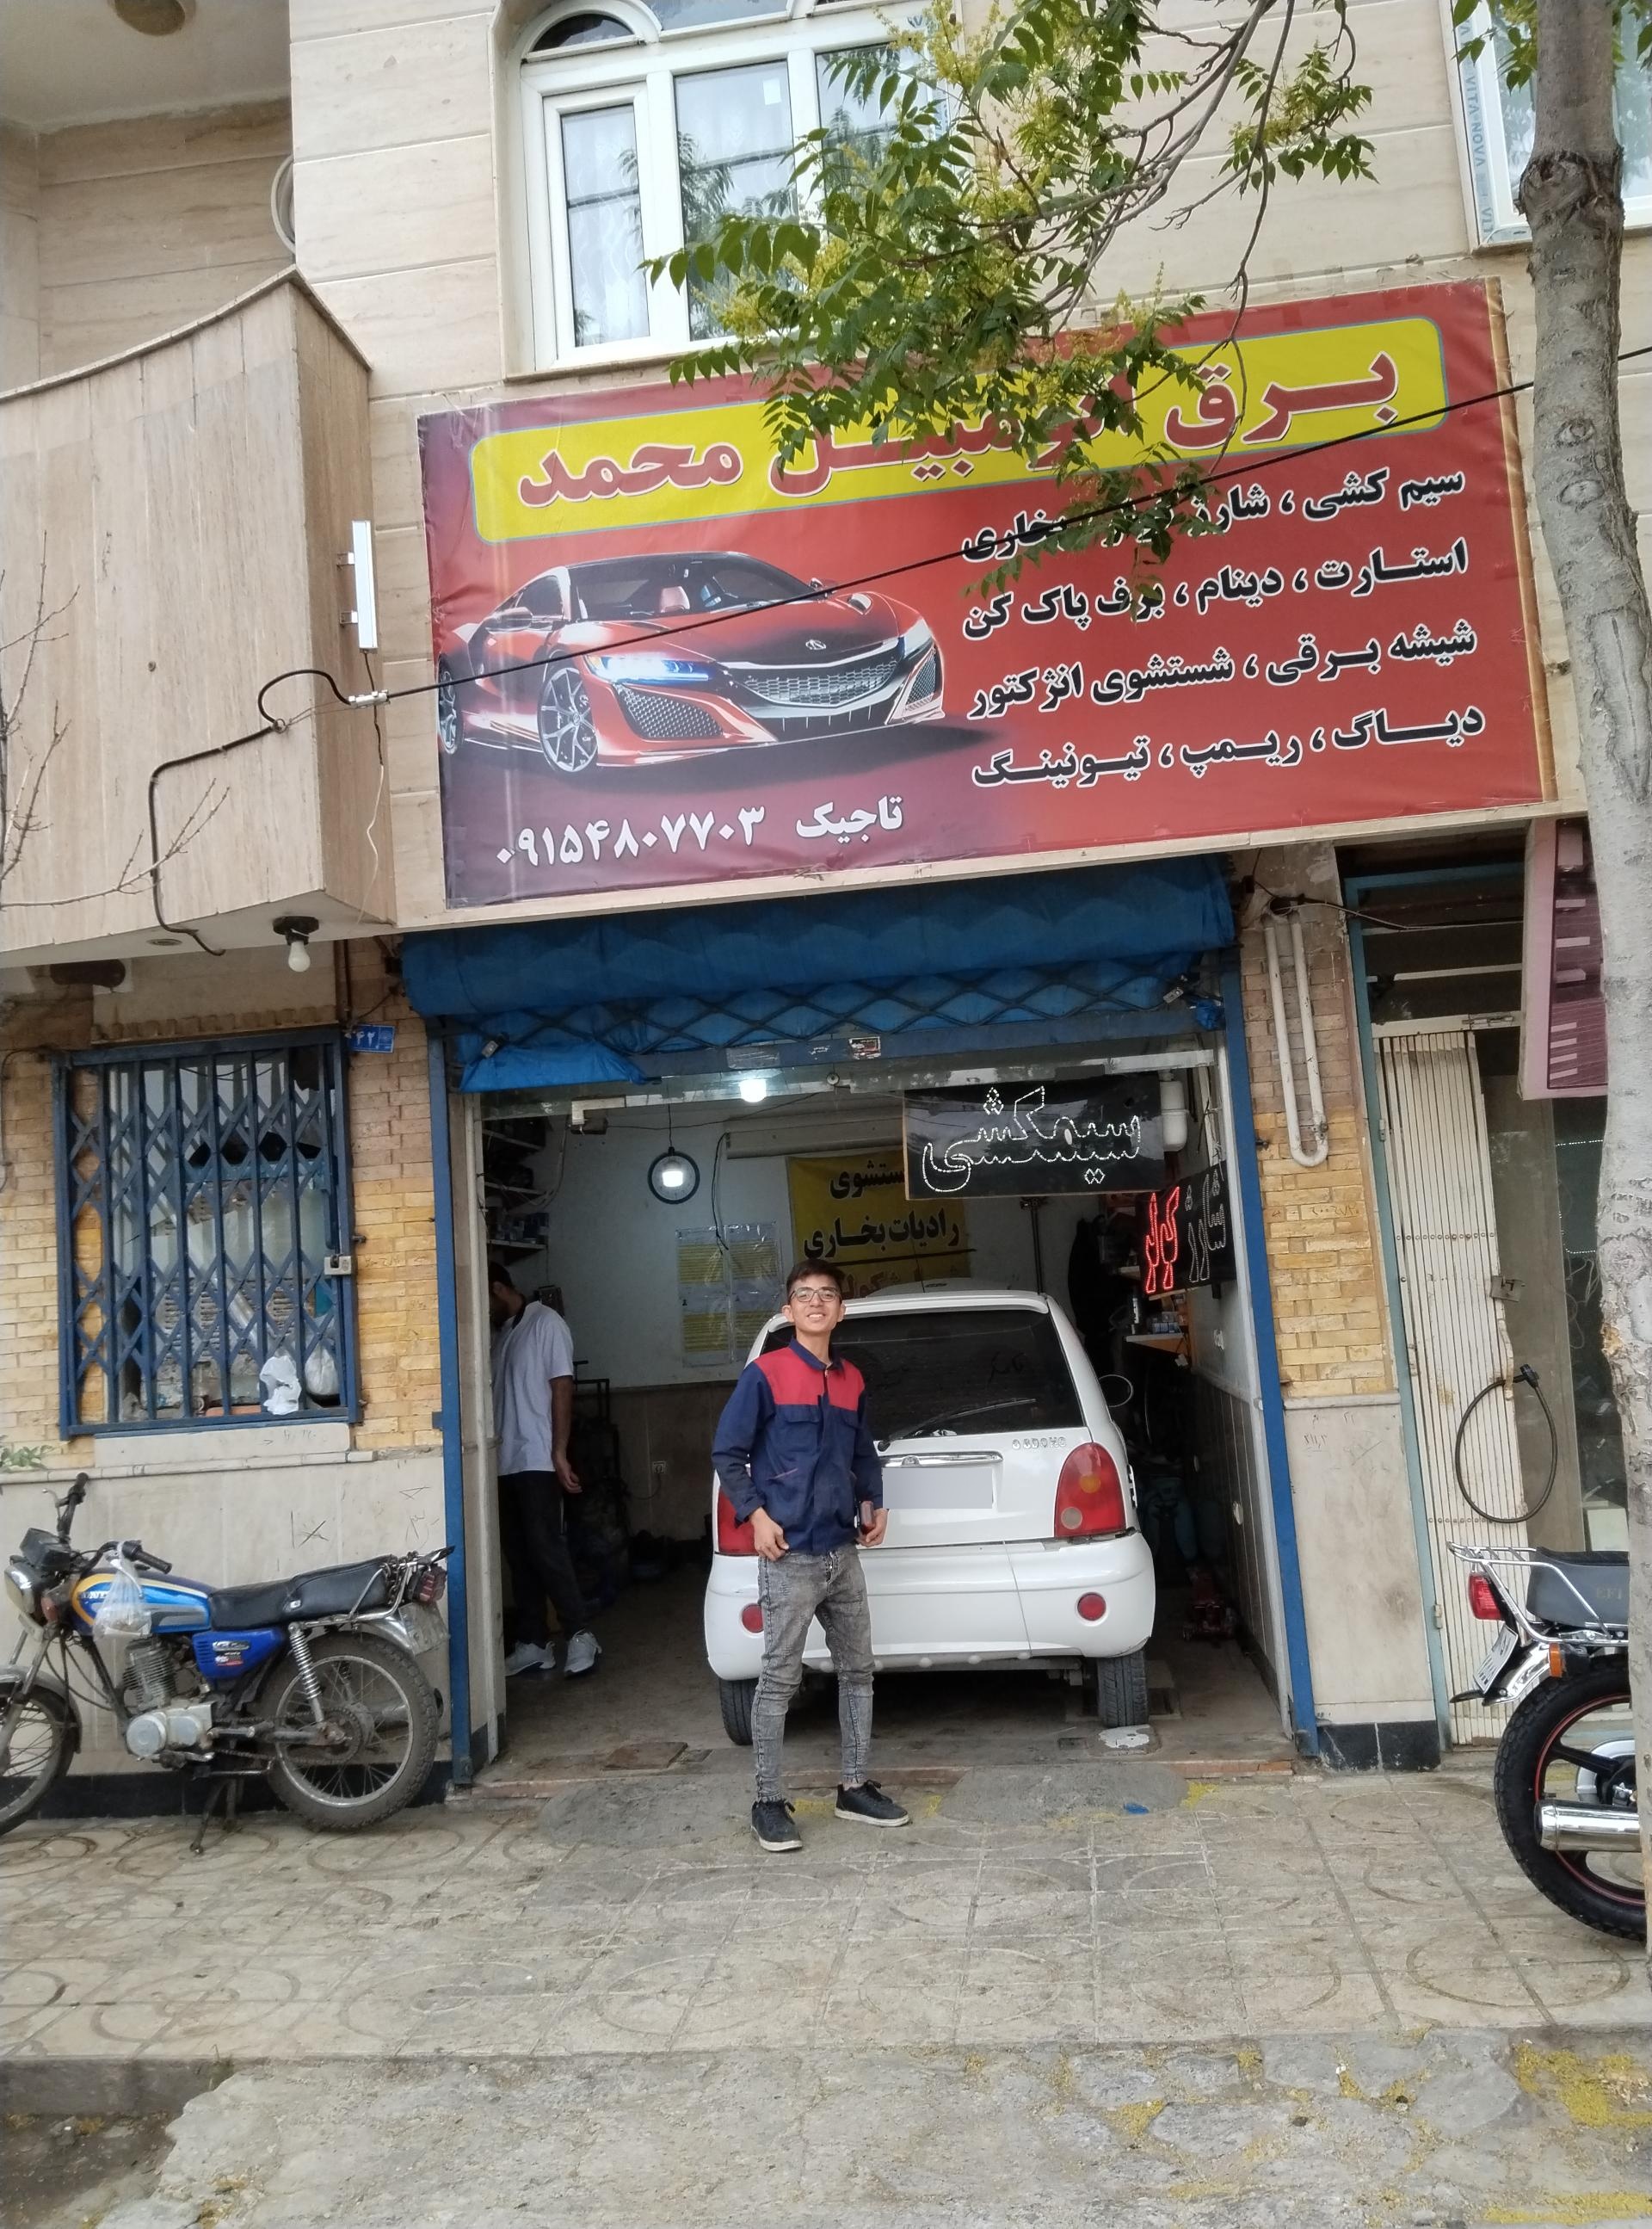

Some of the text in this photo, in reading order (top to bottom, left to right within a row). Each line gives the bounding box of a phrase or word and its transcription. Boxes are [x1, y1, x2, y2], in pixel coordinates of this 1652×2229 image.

[1470, 122, 1487, 167] NOVA
[1164, 351, 1400, 451] برق
[518, 441, 744, 509] محمد
[1304, 466, 1390, 521] کشی
[1396, 471, 1466, 512] سیم
[1188, 483, 1271, 538] شارژ
[961, 509, 1093, 564] خاری
[1196, 563, 1285, 614] دینام
[1315, 537, 1469, 597] استارت
[962, 592, 1015, 640] کن
[1021, 585, 1093, 629] پاک
[1094, 576, 1166, 621] برف
[1266, 633, 1382, 687] برقی
[1388, 619, 1478, 668] شیشه
[1090, 646, 1234, 707] شستشوی
[1331, 705, 1487, 748] دیاگ
[971, 736, 1151, 788] تیونینگ
[1180, 730, 1304, 777] ریمپ
[496, 794, 904, 868] تاجیک ۰۹۱۵۴۸۰۷۷۰۳
[829, 1158, 904, 1200] ستشوی
[804, 1214, 886, 1259] بخاری
[860, 1207, 959, 1248] رادیات
